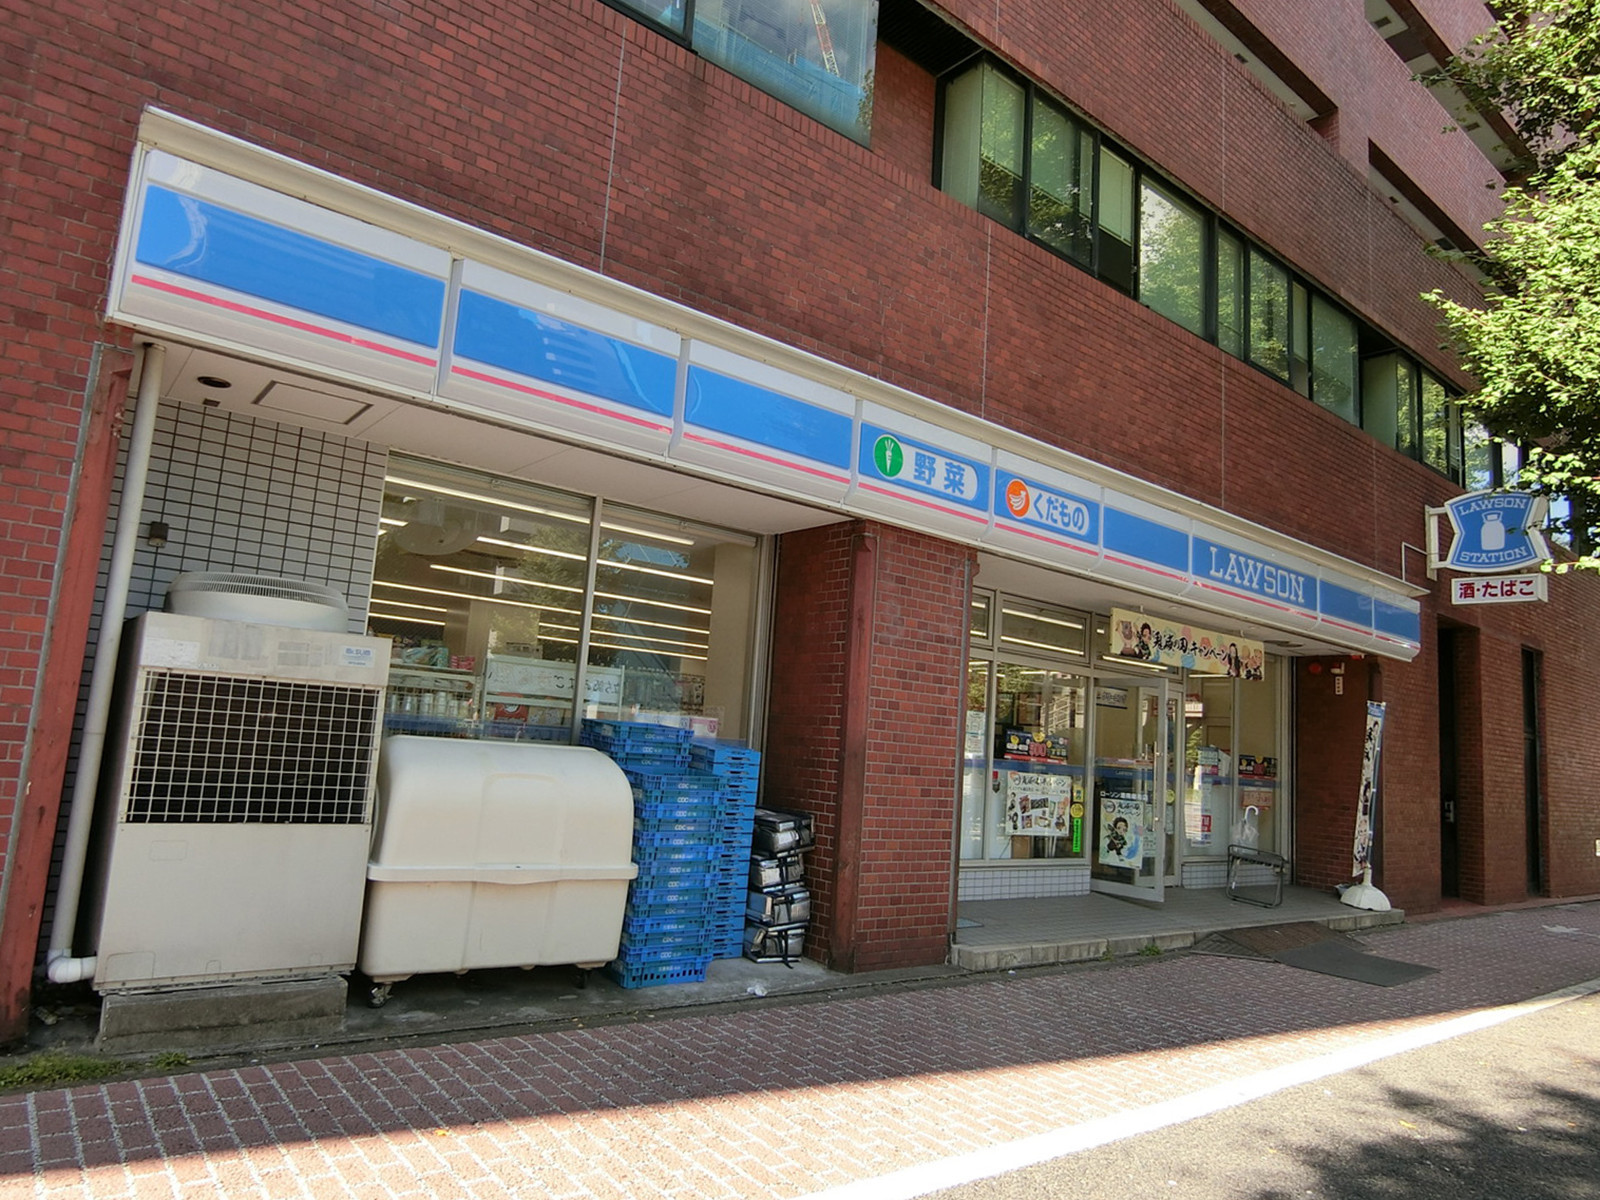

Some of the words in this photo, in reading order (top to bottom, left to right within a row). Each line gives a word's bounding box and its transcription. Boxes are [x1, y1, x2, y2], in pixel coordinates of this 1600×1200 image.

[914, 451, 965, 495] 野菜
[1033, 493, 1085, 531] くだもの
[1459, 497, 1527, 515] LAWSON
[1460, 547, 1528, 563] STATION
[1209, 546, 1305, 604] LAWSON
[1459, 580, 1534, 599] 酒・たばこ
